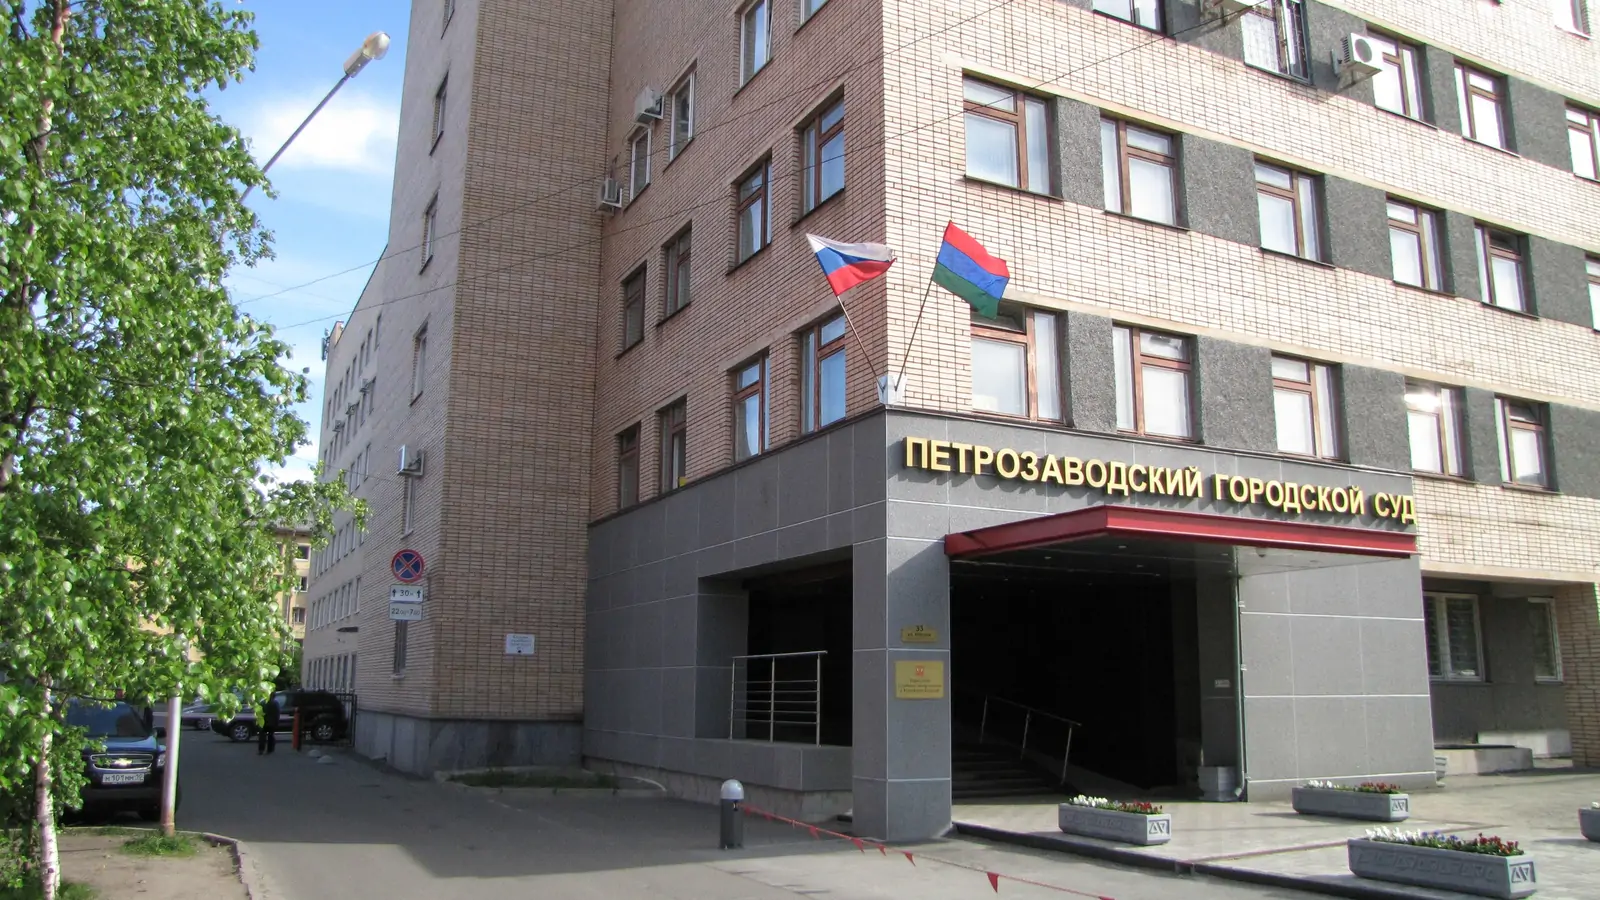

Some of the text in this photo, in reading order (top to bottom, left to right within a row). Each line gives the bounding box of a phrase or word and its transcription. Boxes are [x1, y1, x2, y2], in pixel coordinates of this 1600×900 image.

[904, 436, 1417, 525] ПЕТРОЗАВОДСКИЙ ГОРОДСКОЙ СУД
[400, 589, 410, 597] 30
